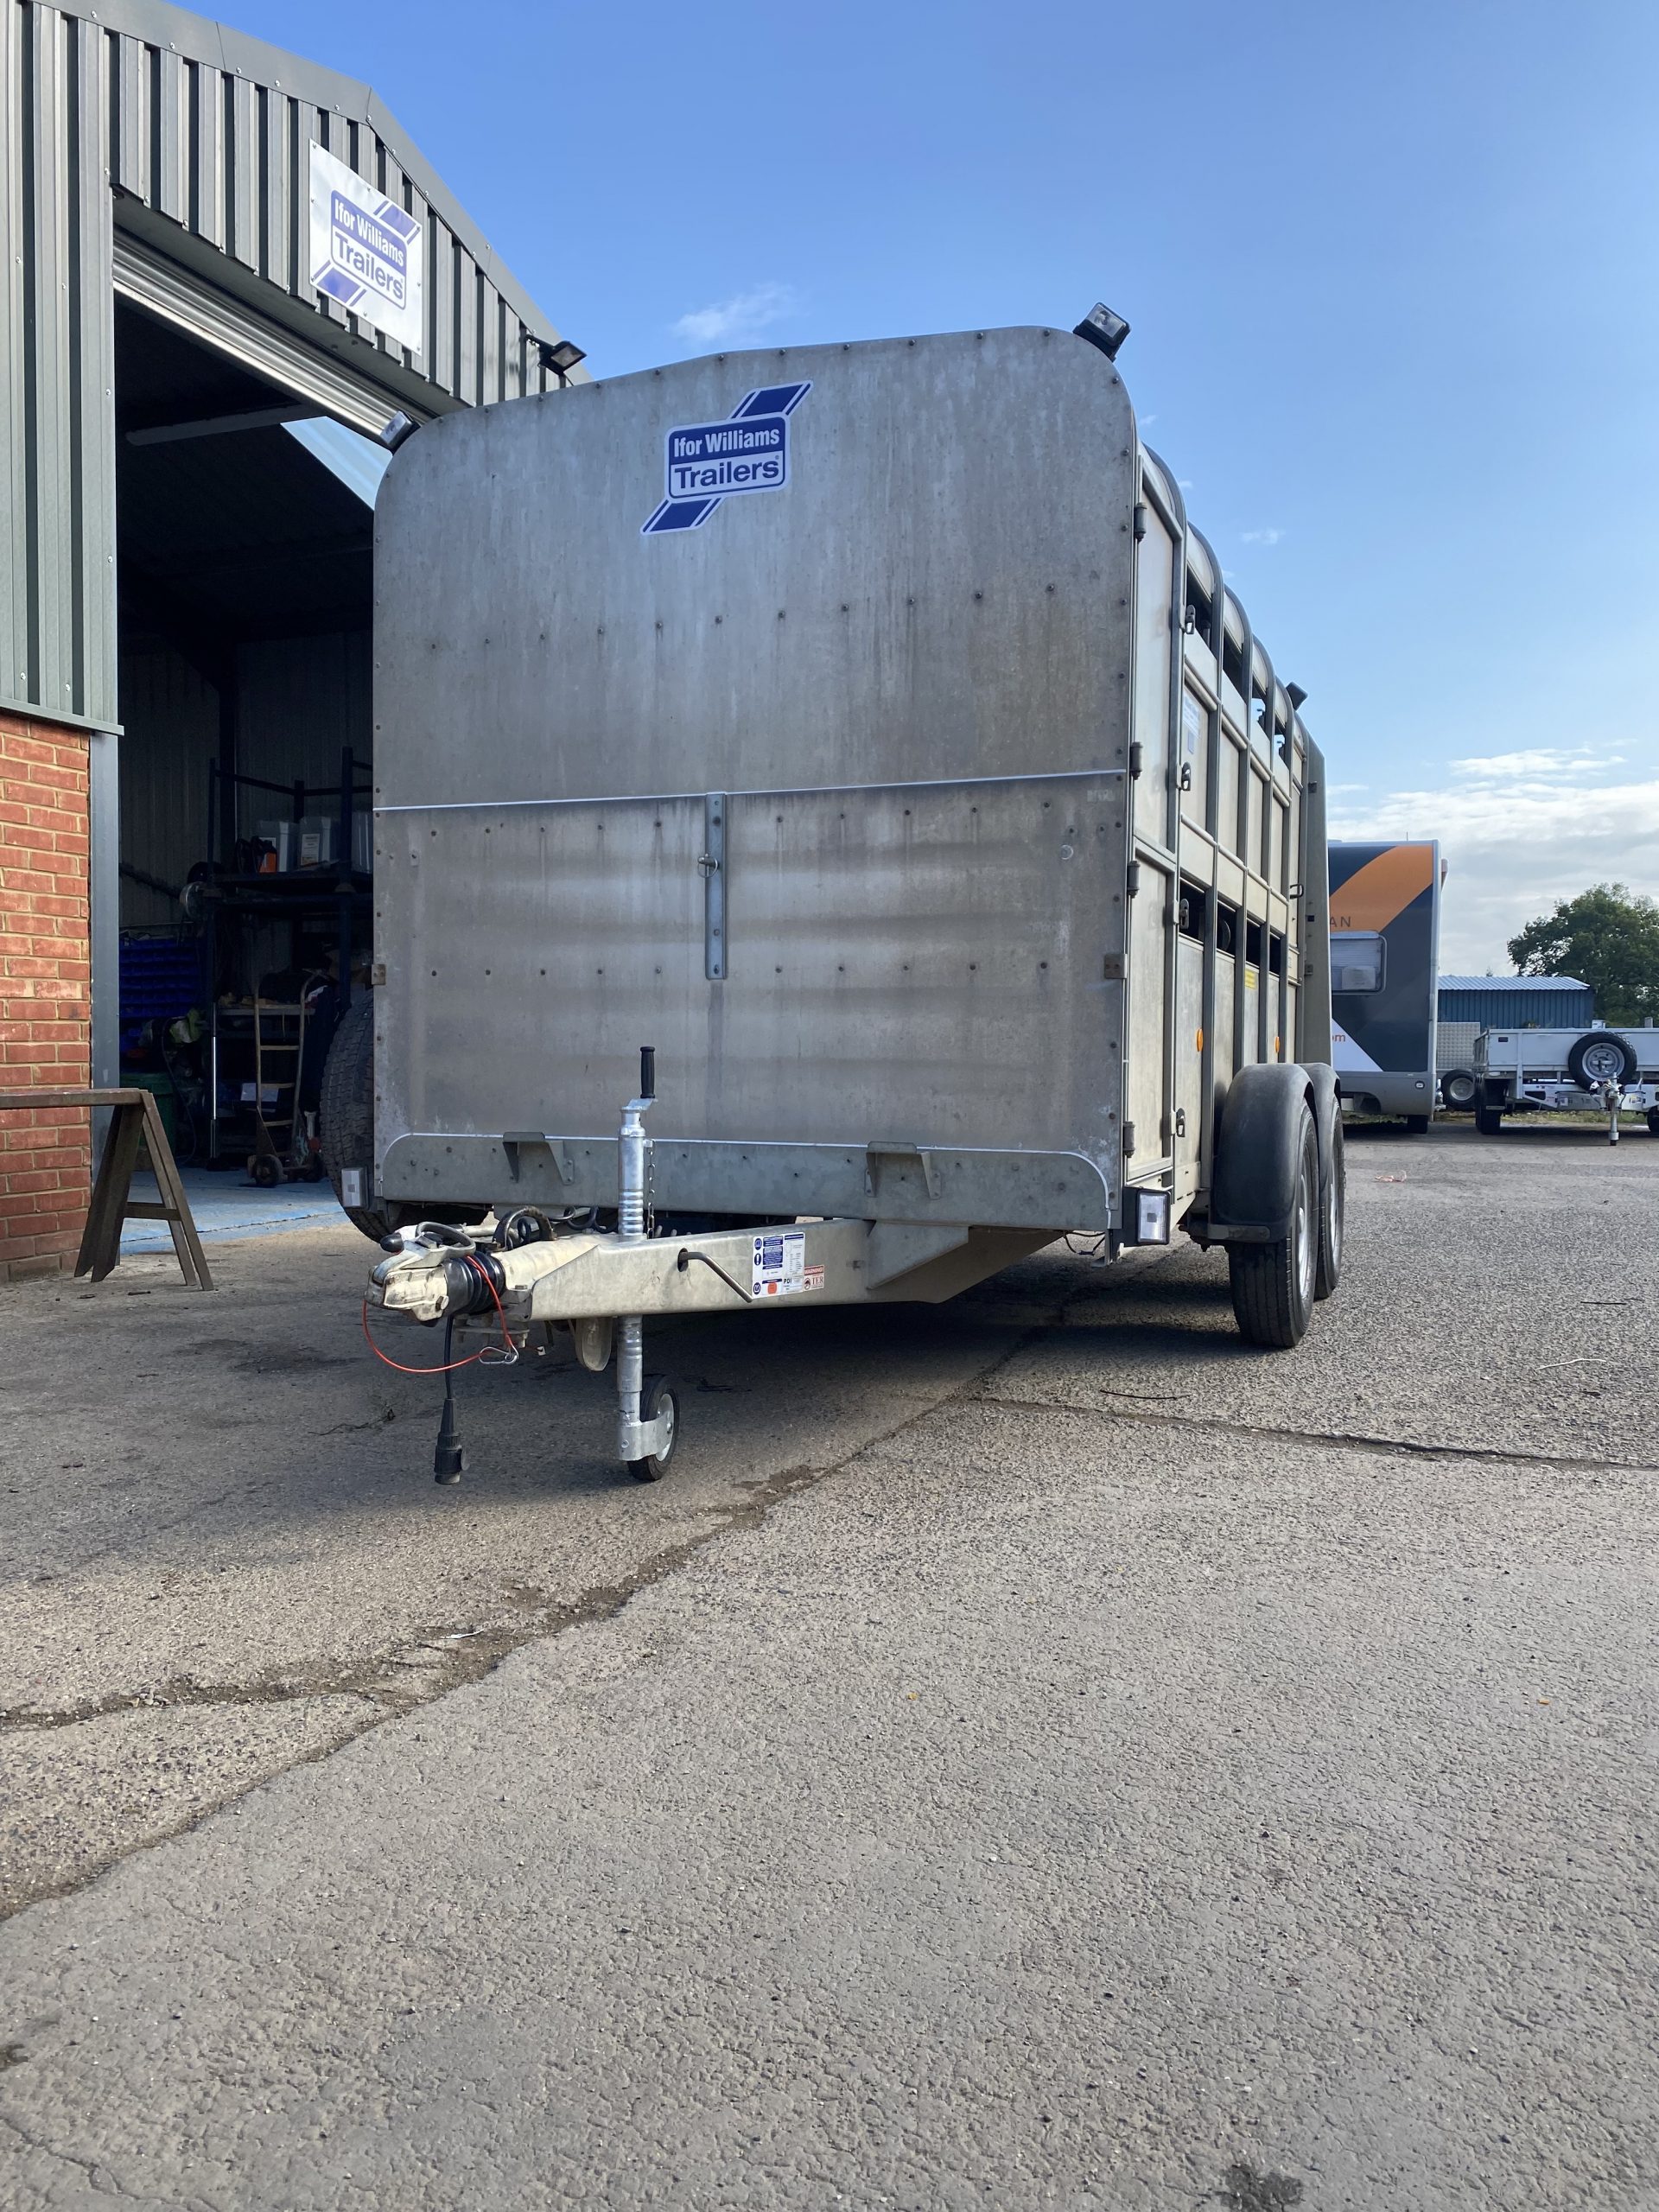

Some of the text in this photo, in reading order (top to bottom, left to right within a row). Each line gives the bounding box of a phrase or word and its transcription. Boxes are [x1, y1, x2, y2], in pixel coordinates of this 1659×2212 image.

[334, 199, 404, 266] Ifor Williams
[334, 232, 404, 300] Trailers
[674, 429, 780, 457] Ifor Williams
[675, 460, 779, 488] Trailers
